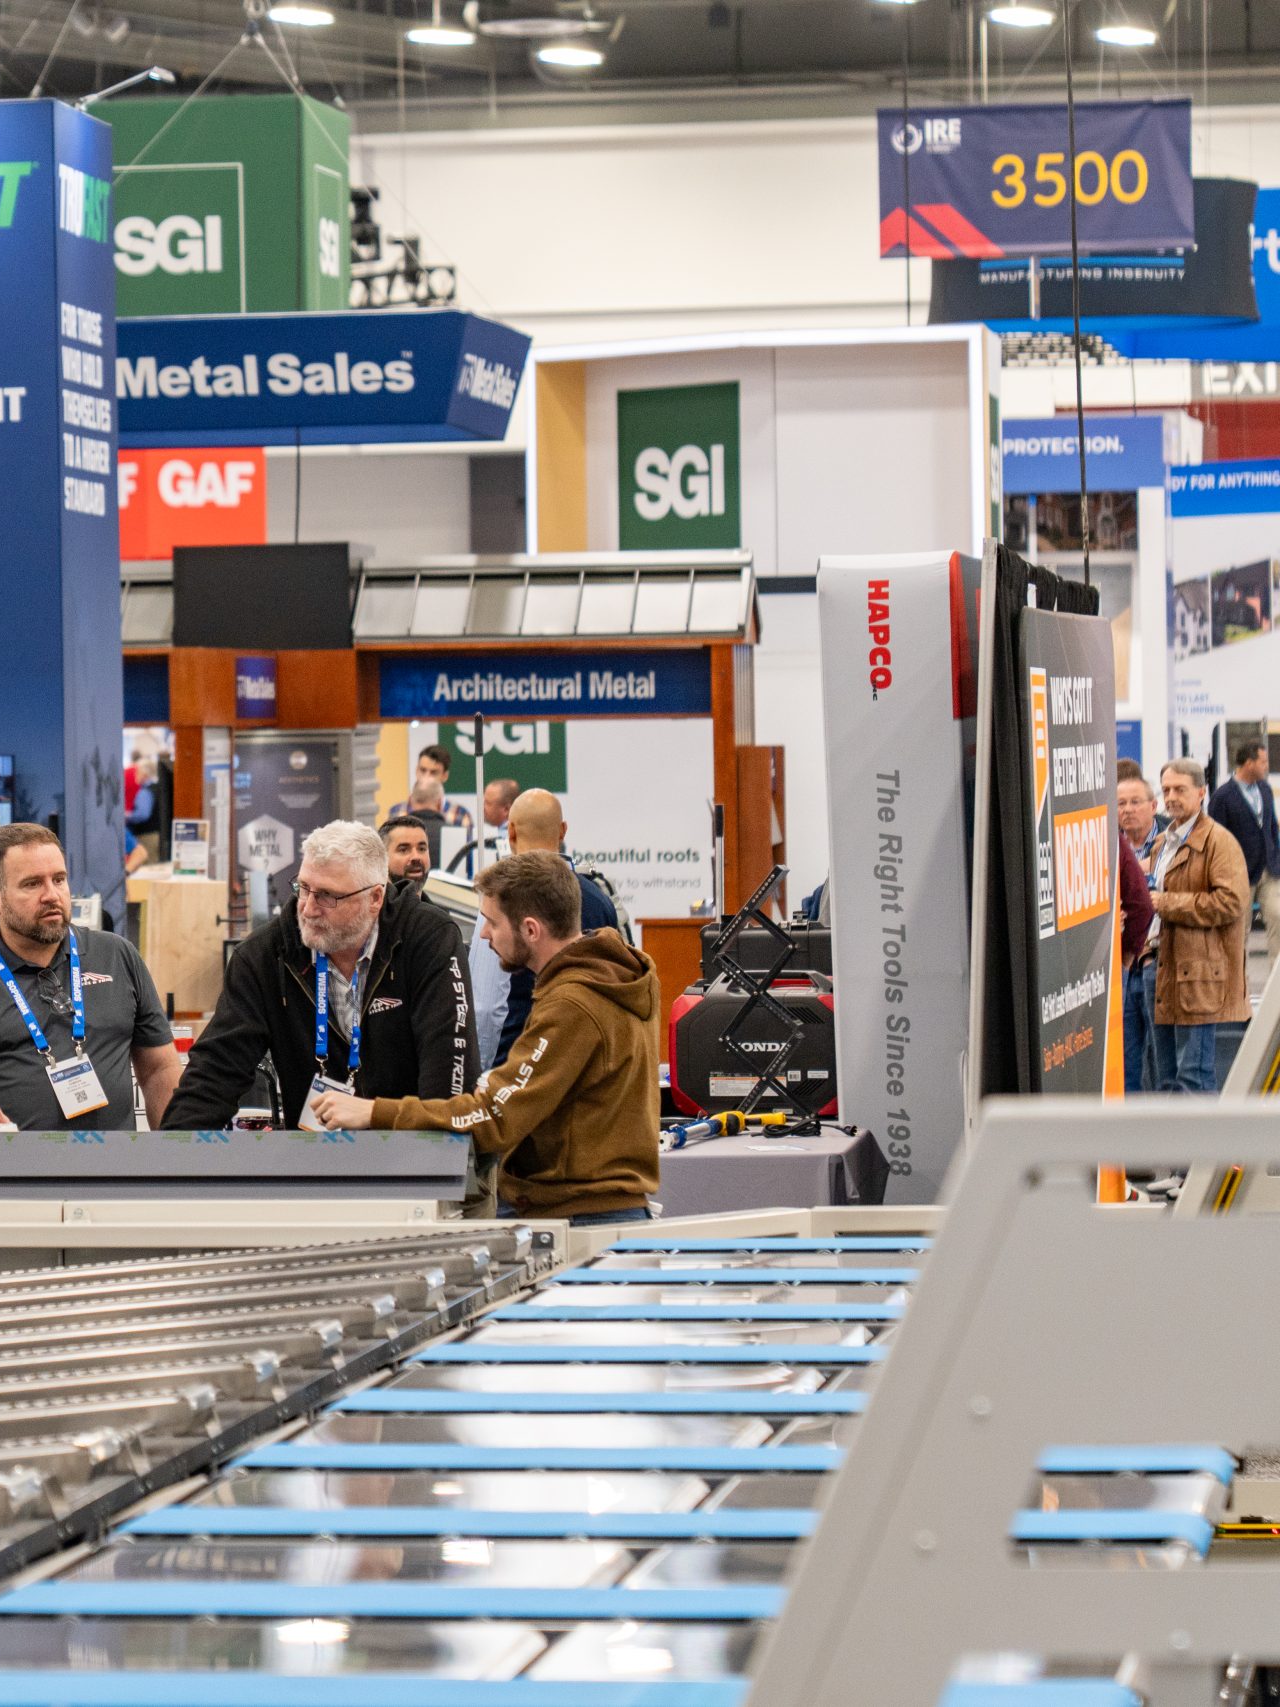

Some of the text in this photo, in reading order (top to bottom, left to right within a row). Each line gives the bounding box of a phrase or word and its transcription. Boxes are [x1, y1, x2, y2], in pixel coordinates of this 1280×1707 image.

[924, 118, 961, 144] IRE
[991, 150, 1148, 208] 3500
[113, 215, 222, 275] SGI
[319, 216, 339, 277] SGI
[116, 356, 258, 399] Metal
[1203, 361, 1276, 393] EXI
[1003, 435, 1124, 455] PROTECION.
[158, 461, 255, 508] GAF
[634, 444, 724, 521] SGI
[1190, 474, 1215, 491] FOR
[867, 579, 892, 690] HAPCO
[433, 670, 656, 701] Architectural Metal
[1053, 746, 1077, 797] BETTER
[1077, 743, 1095, 793] THAN
[254, 829, 278, 842] WHY
[573, 848, 700, 864] beautiful roofs
[1055, 815, 1109, 918] NOBODY!
[317, 972, 326, 1014] SOPREMA
[873, 769, 912, 1177] The Right Tools Since 1938
[6, 980, 30, 1015] SOPREMA
